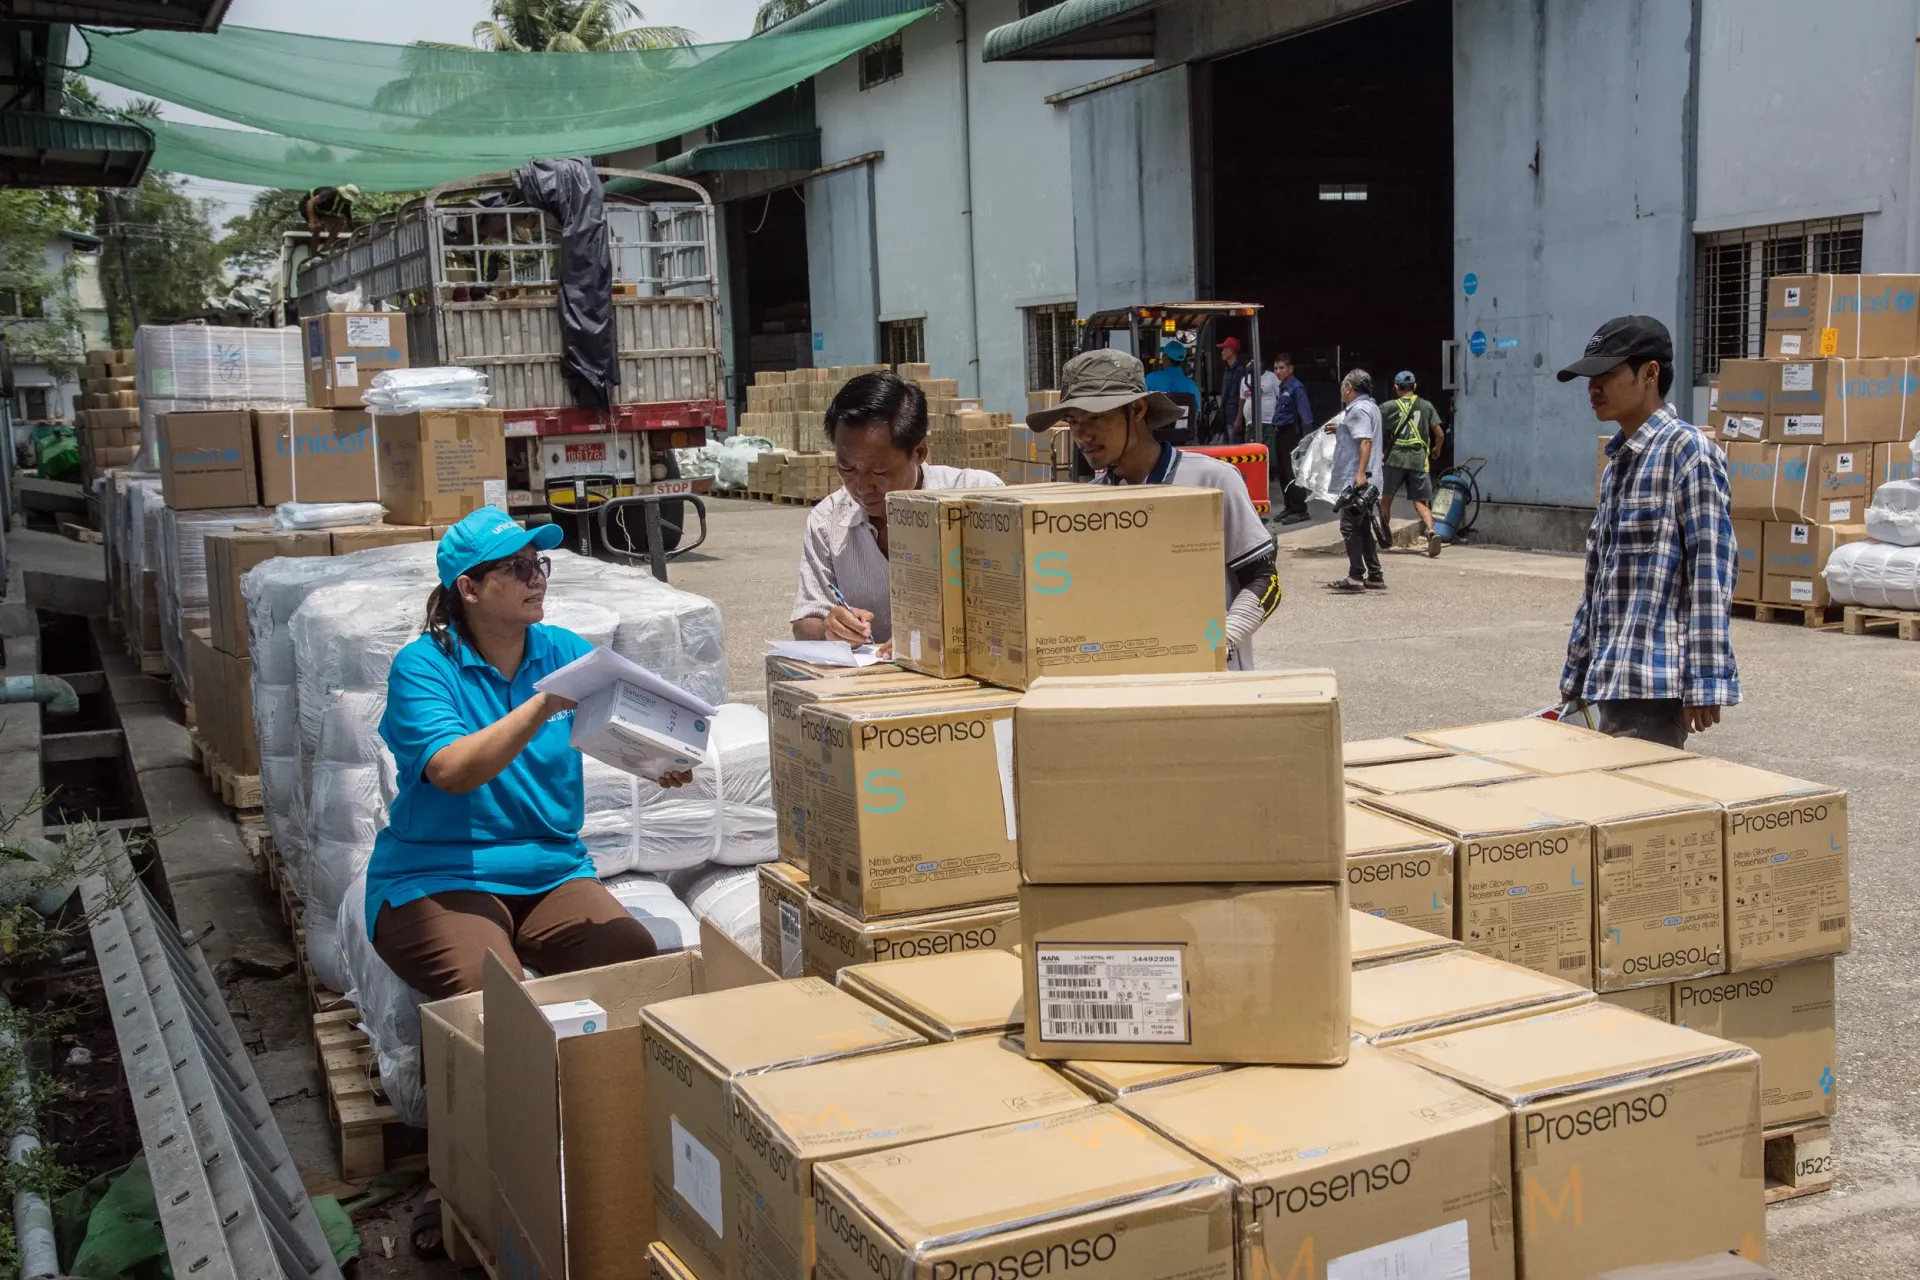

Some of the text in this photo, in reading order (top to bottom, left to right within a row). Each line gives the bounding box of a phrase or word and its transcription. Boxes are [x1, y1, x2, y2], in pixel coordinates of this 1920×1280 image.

[1831, 288, 1893, 314] unicef
[1837, 372, 1897, 399] unicef
[276, 425, 371, 456] unicef
[656, 483, 689, 494] STOP
[887, 502, 929, 529] Prosenso
[964, 504, 1010, 532] Prosenso
[1032, 508, 1149, 535] Prosenso
[1032, 551, 1072, 595] S
[1035, 634, 1086, 646] Nitrile Gloves
[860, 718, 986, 751] Prosenso
[863, 769, 906, 815] S
[1732, 804, 1828, 836] Prosenso
[1468, 837, 1568, 866] Prosenso
[1830, 832, 1843, 851] L
[868, 853, 923, 867] Nitrile Gloves
[869, 864, 913, 877] Prosenso
[1347, 859, 1431, 884] osenso
[1571, 866, 1585, 886] L
[1432, 890, 1446, 910] L
[873, 927, 997, 963] Prosenso
[1679, 977, 1774, 1009] Prosenso
[1133, 1026, 1139, 1035] 8
[643, 1024, 693, 1088] Prosenso
[1525, 1093, 1667, 1149] Prosenso
[1795, 1156, 1832, 1178] 0523
[1252, 1158, 1411, 1223] Prosenso
[1525, 1163, 1584, 1237] M
[815, 1181, 892, 1280] Prosenso
